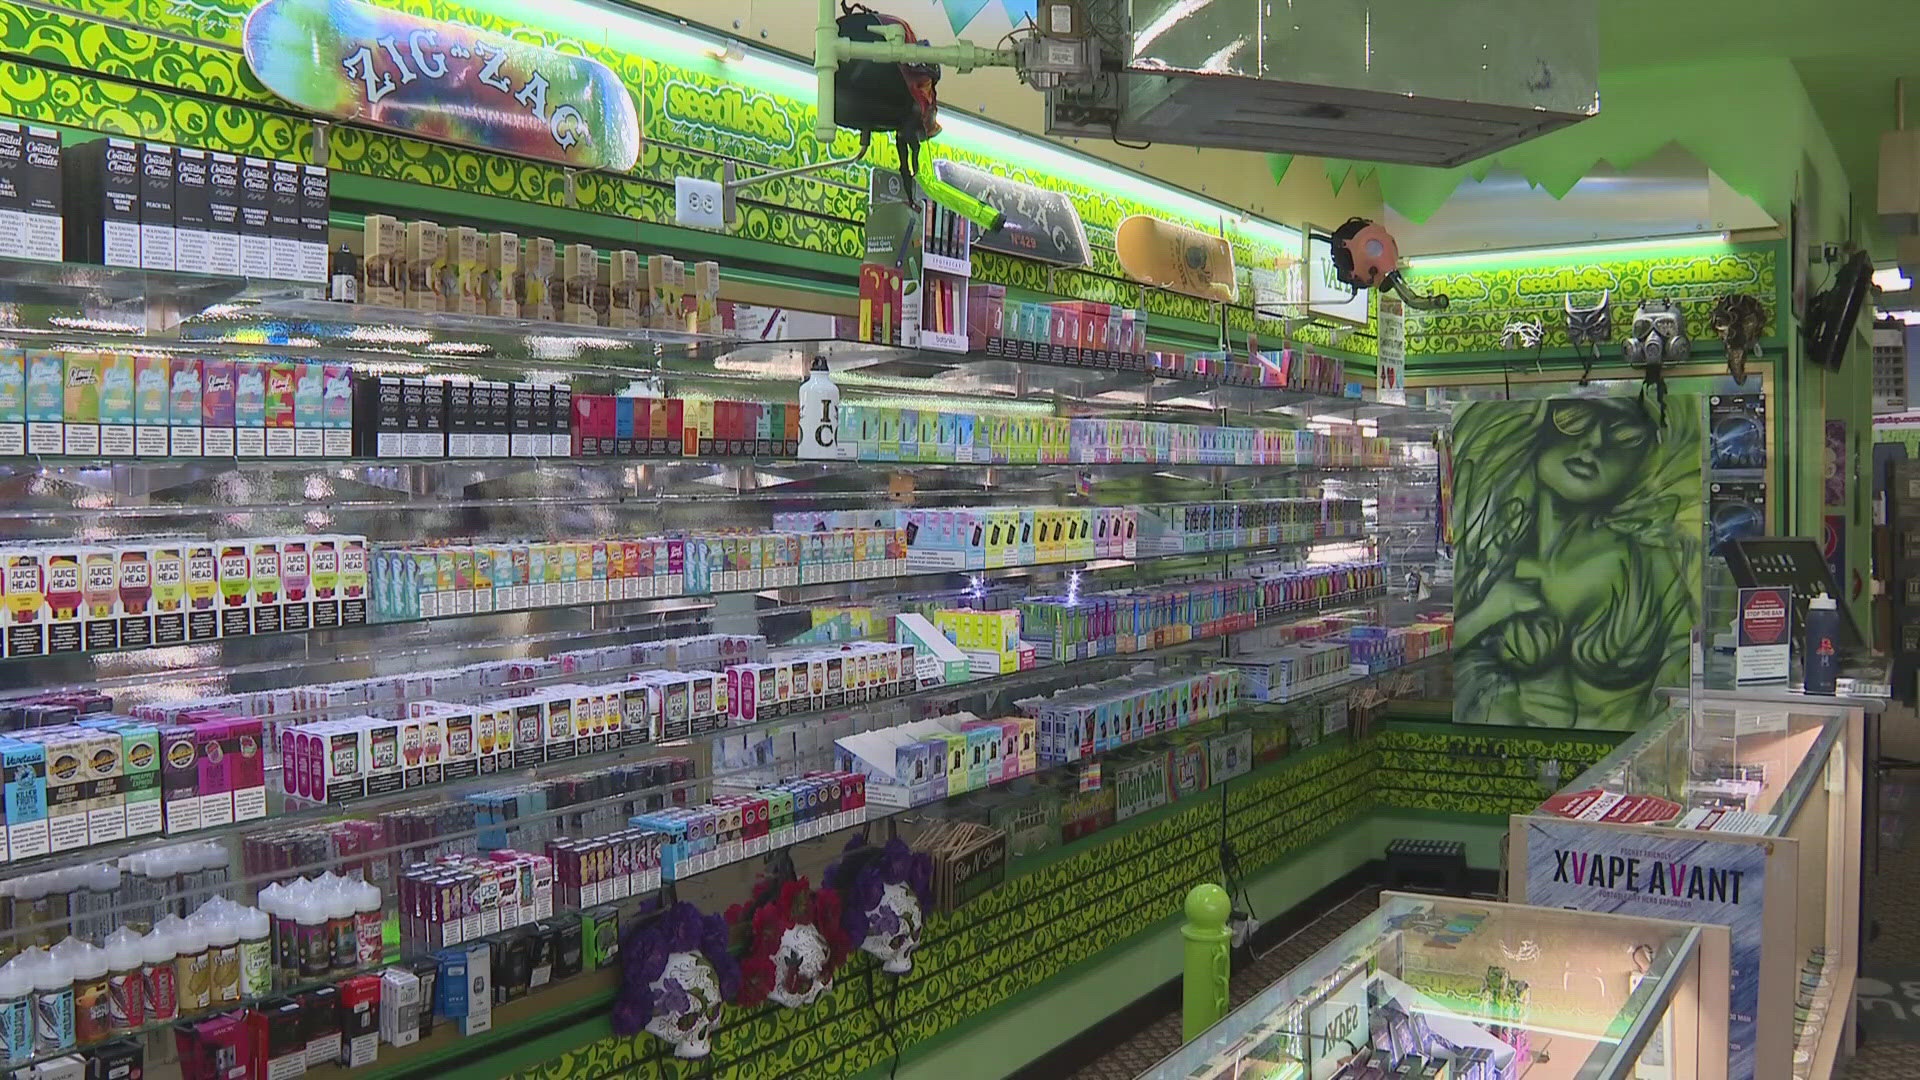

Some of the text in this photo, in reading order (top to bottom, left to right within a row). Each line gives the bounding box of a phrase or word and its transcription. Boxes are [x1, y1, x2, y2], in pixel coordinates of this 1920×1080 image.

[27, 142, 59, 155] Coastal
[28, 153, 58, 166] Clouds
[107, 148, 137, 162] Coastal
[144, 154, 172, 167] Coastal
[108, 161, 135, 173] Clouds
[145, 165, 171, 177] Clouds
[178, 162, 205, 174] Coastal
[211, 163, 238, 175] Coastal
[243, 168, 269, 179] Coastal
[273, 172, 298, 183] Coastal
[180, 173, 205, 184] Clouds
[212, 174, 236, 185] Clouds
[303, 176, 328, 187] Coastal
[244, 179, 268, 190] Clouds
[274, 182, 297, 193] Clouds
[304, 186, 326, 197] Clouds
[146, 201, 161, 209] PEACH
[380, 223, 394, 231] JUST
[423, 229, 435, 237] JUST
[503, 240, 516, 248] JUST
[821, 400, 831, 423] I
[815, 424, 833, 447] C
[257, 557, 276, 565] JUICE
[286, 555, 305, 563] JUICE
[315, 553, 333, 562] JUICE
[344, 552, 362, 561] JUICE
[158, 562, 179, 571] JUICE
[191, 560, 211, 569] JUICE
[225, 559, 245, 568] JUICE
[286, 564, 305, 572] HEAD
[316, 562, 333, 570] HEAD
[345, 561, 362, 569] HEAD
[53, 568, 76, 578] JUICE
[90, 567, 112, 577] JUICE
[123, 564, 146, 573] JUICE
[225, 568, 245, 576] HEAD
[257, 566, 276, 574] HEAD
[12, 568, 36, 579] JUICE
[158, 572, 179, 581] HEAD
[192, 570, 212, 578] HEAD
[90, 577, 112, 586] HEAD
[124, 574, 146, 583] HEAD
[12, 581, 36, 589] HEAD
[53, 579, 76, 588] HEAD
[1553, 850, 1744, 904] XVAPE AVANT
